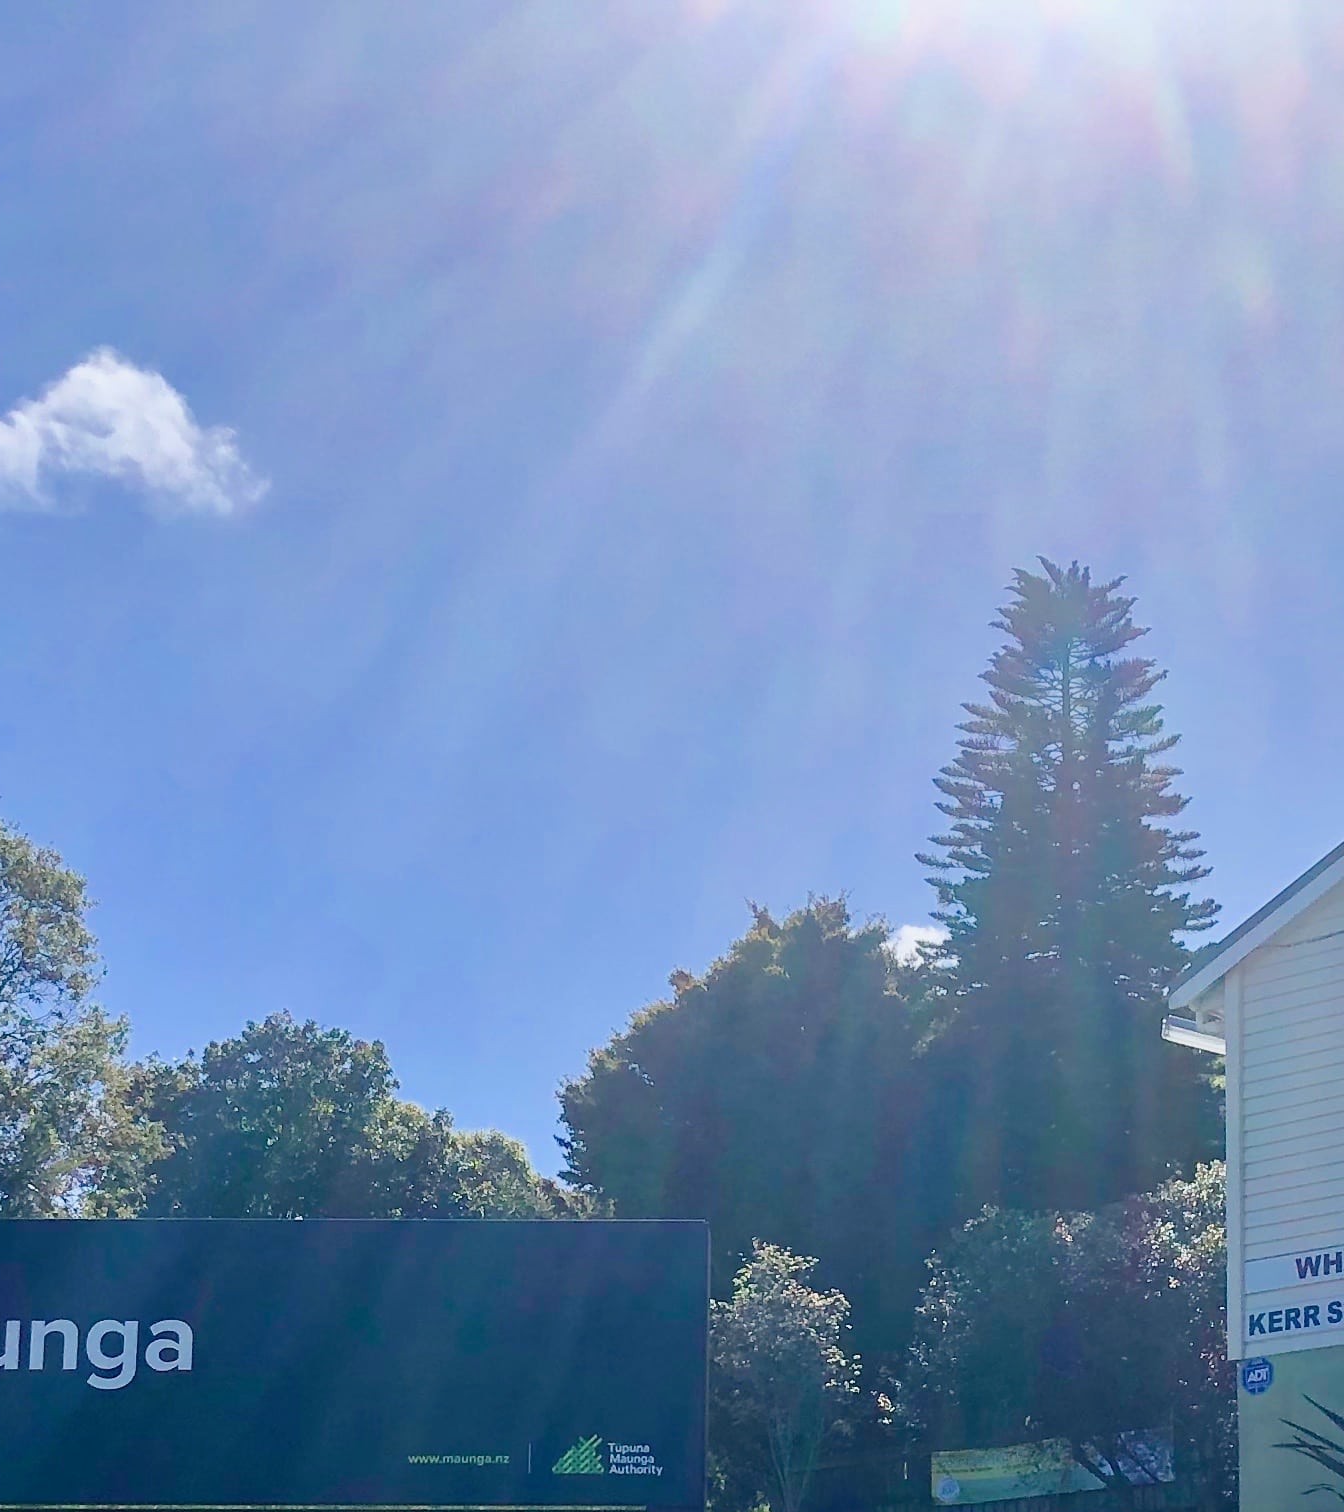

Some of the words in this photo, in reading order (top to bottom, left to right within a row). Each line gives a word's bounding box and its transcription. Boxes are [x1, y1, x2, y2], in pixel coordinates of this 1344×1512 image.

[1249, 1304, 1320, 1336] KERR
[1247, 1368, 1269, 1382] ADT
[408, 1455, 510, 1466] www.maunga.nz
[609, 1454, 654, 1465] Maunga
[609, 1464, 663, 1476] Authority
